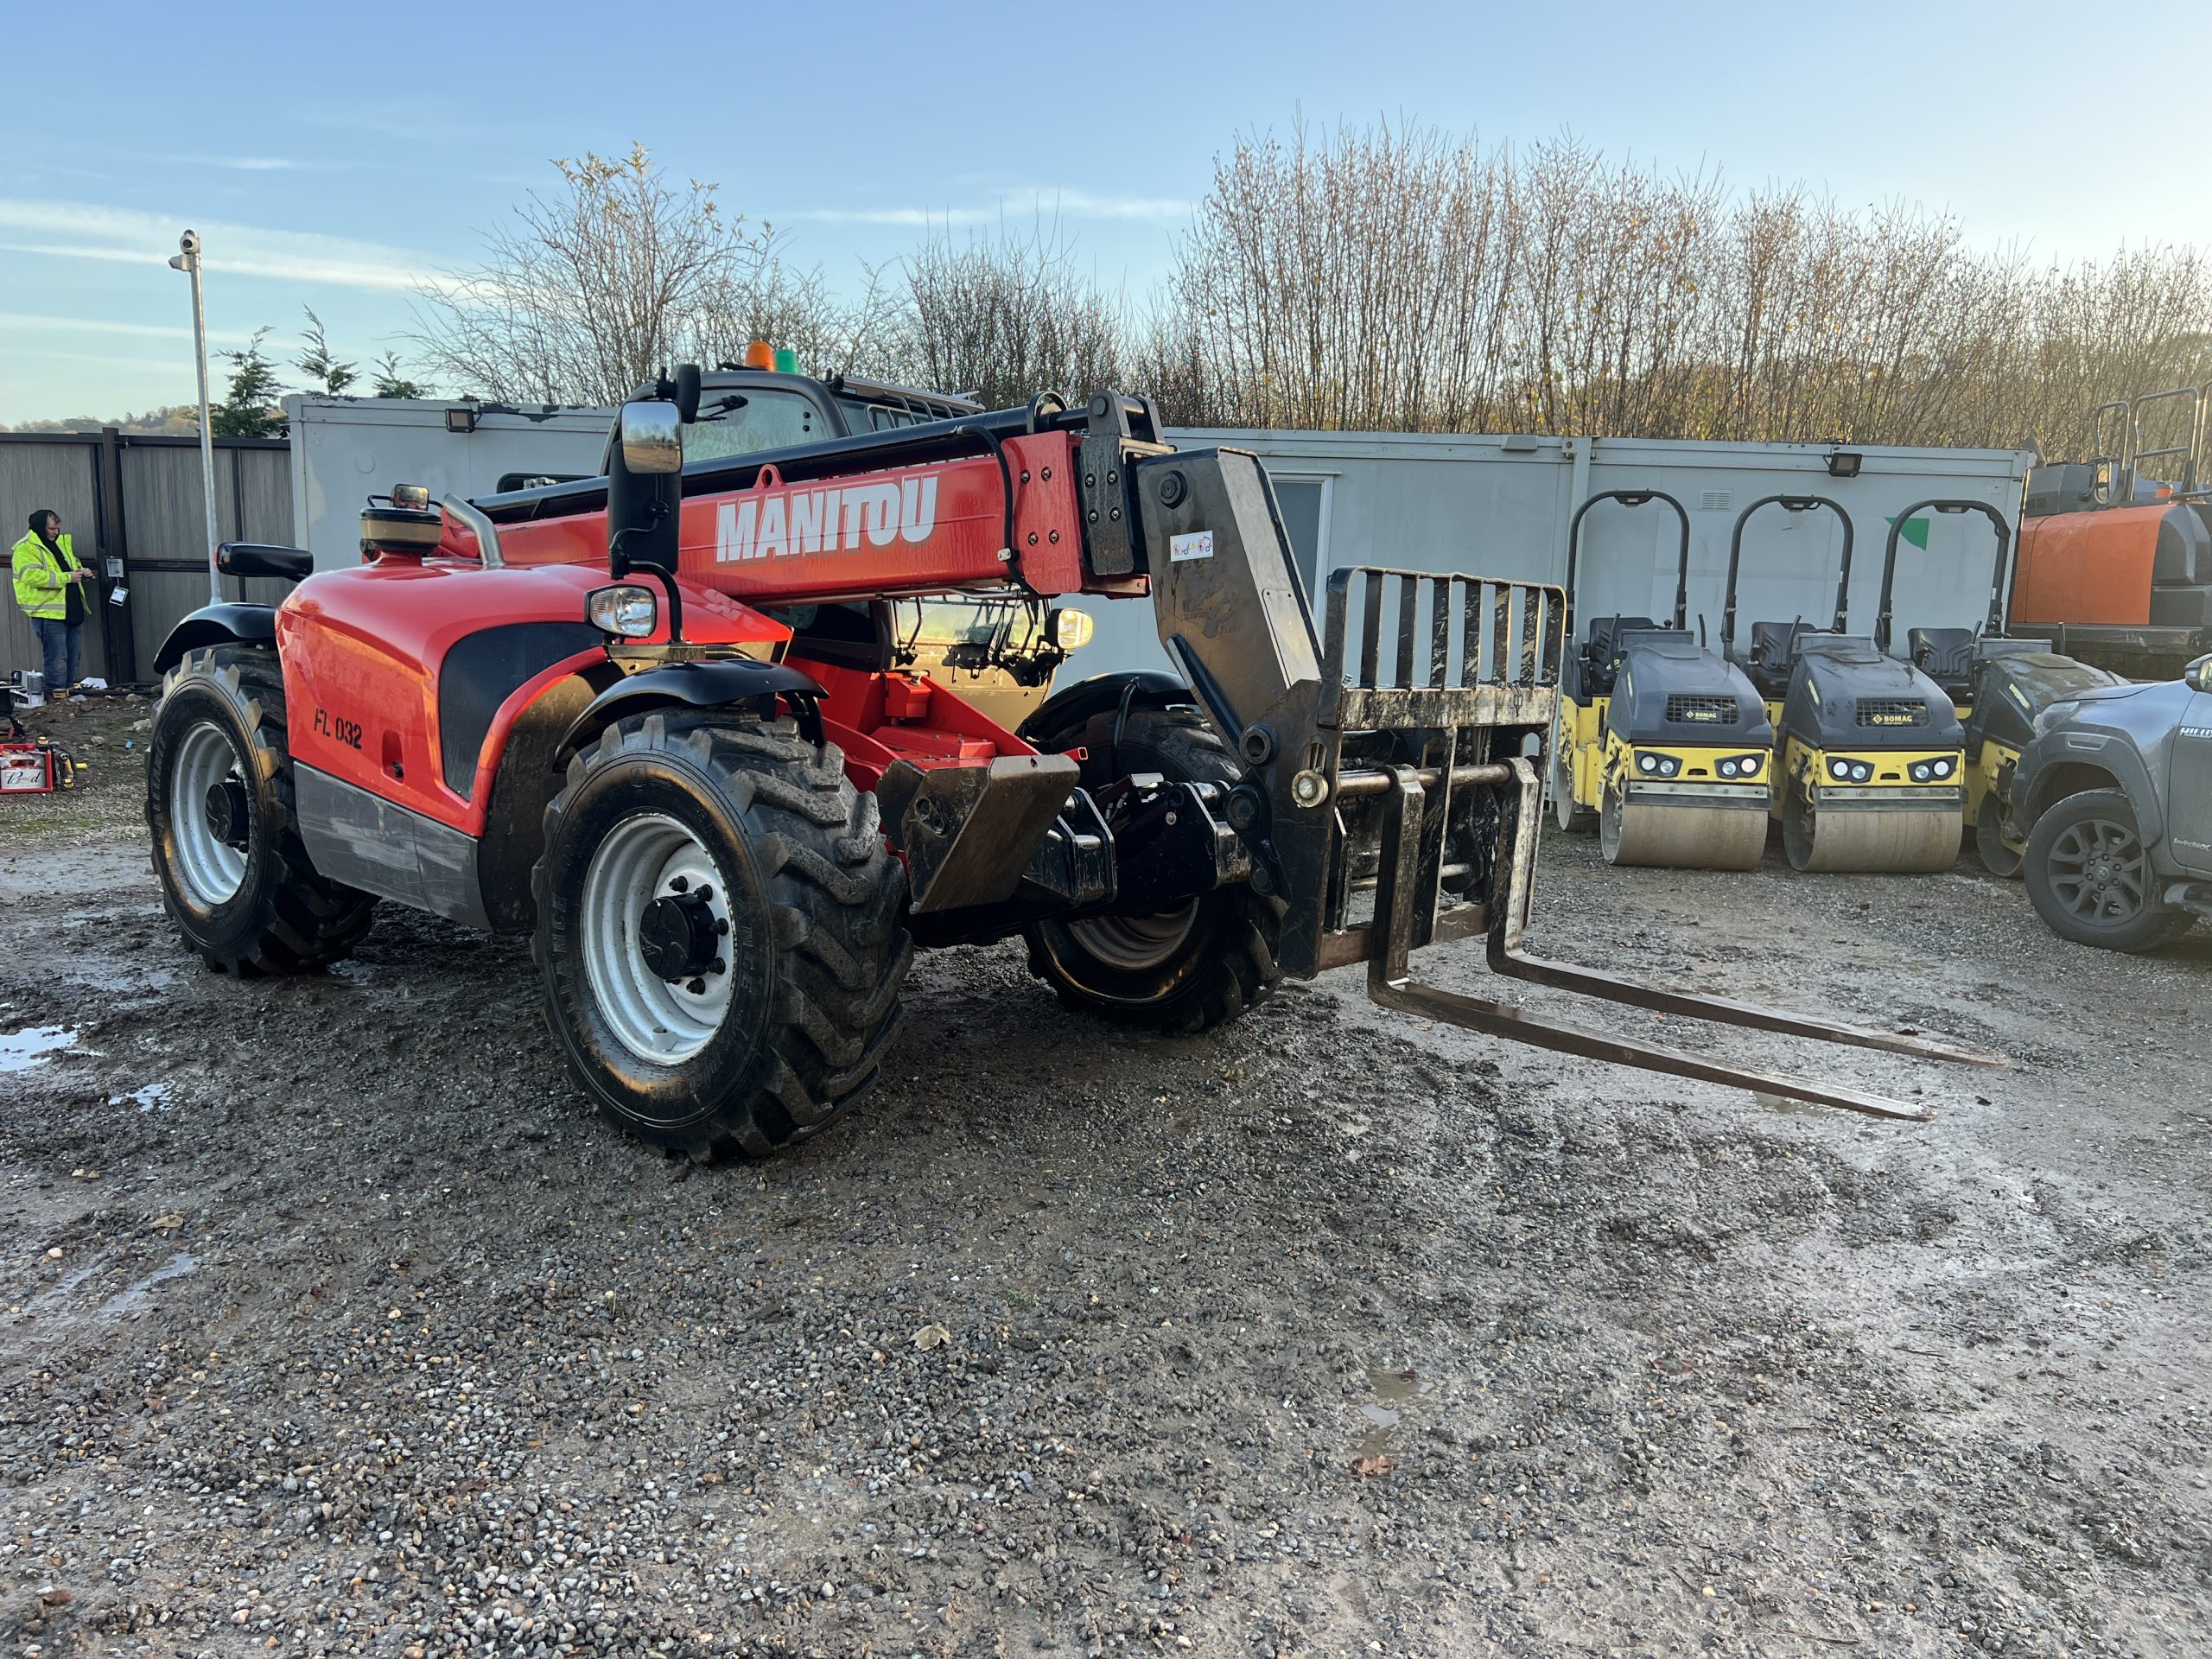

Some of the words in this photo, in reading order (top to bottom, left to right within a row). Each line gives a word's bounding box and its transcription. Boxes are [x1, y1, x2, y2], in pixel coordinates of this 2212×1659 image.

[716, 477, 938, 563] MANITOU
[315, 708, 331, 737] FL
[335, 716, 362, 750] 032
[2179, 727, 2212, 738] HILU
[550, 891, 601, 1049] ALLIANCE
